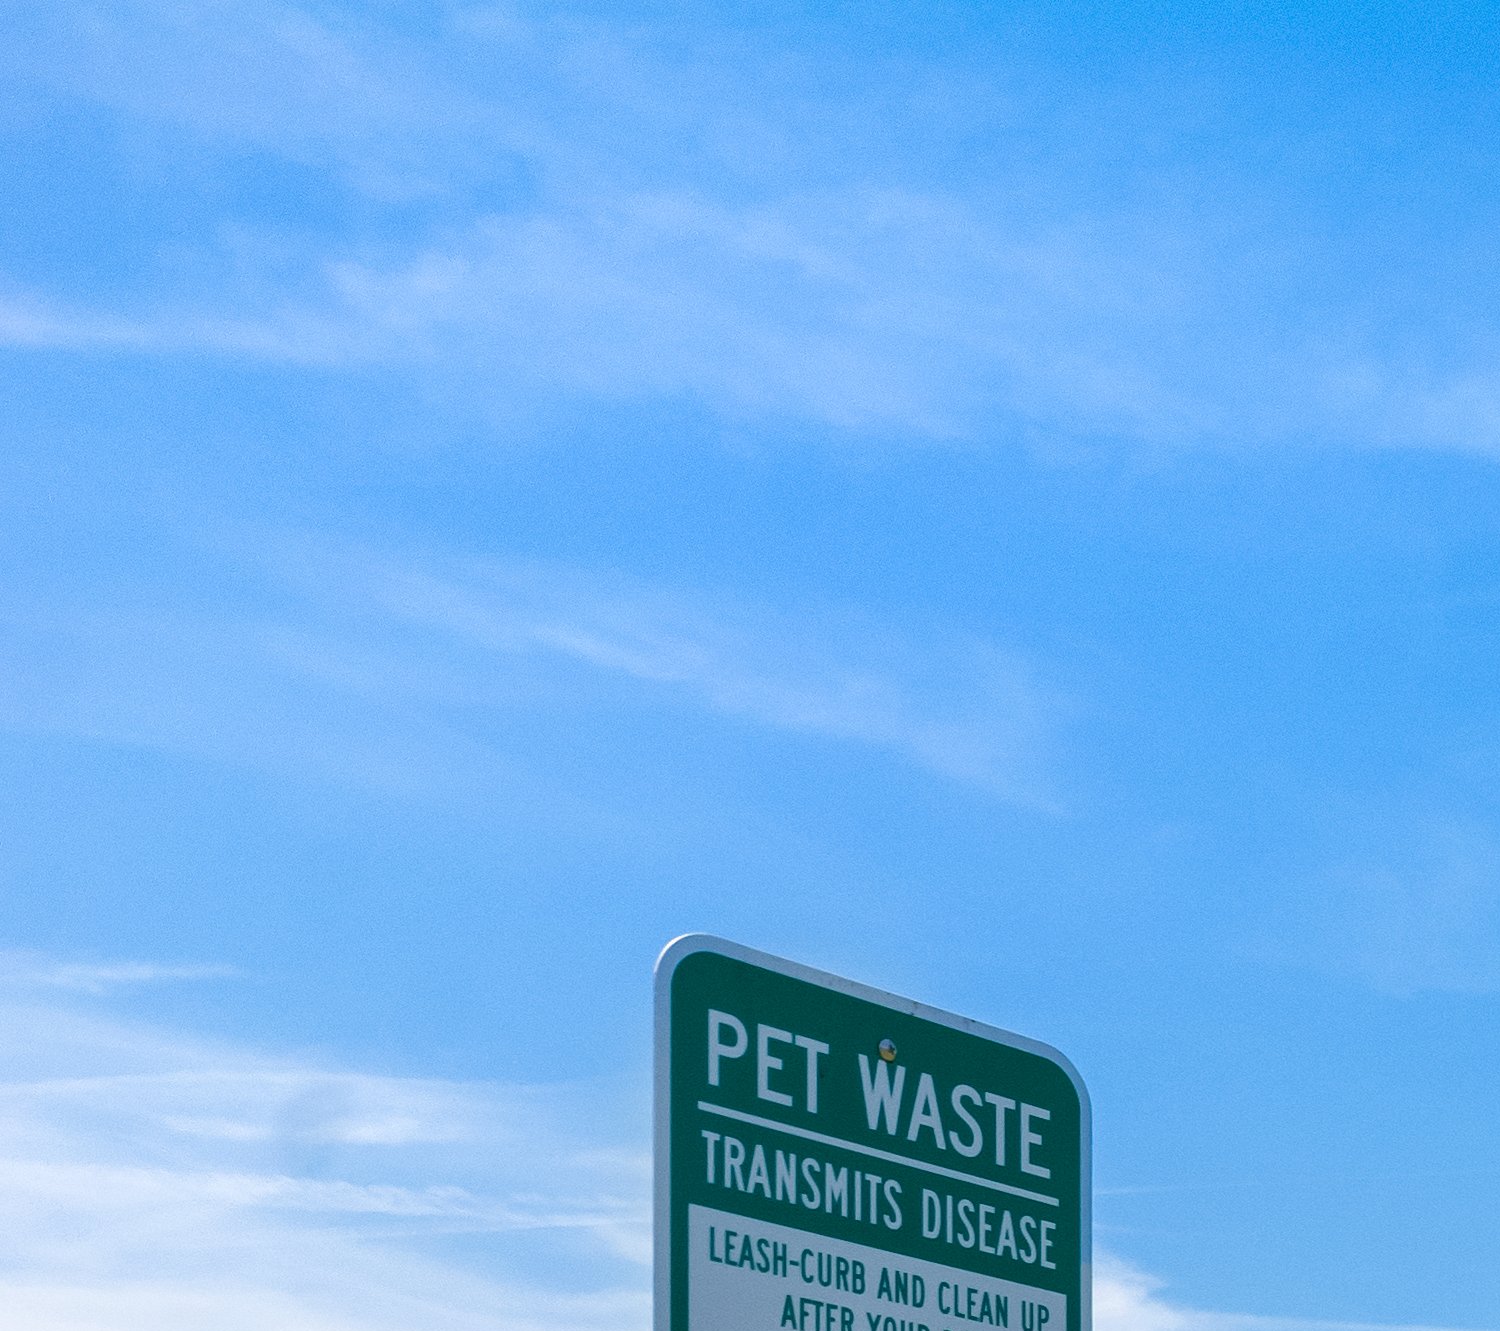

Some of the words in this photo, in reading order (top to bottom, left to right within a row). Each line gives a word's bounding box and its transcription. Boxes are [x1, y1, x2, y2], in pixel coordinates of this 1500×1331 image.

[708, 1008, 829, 1114] PET
[857, 1053, 1051, 1179] WASTE
[701, 1129, 902, 1231] TRANSMITS
[922, 1187, 1056, 1270] DISEASE
[709, 1226, 866, 1295] LEASH-CURB
[877, 1266, 925, 1308] AND
[938, 1281, 1008, 1329] CLEAN
